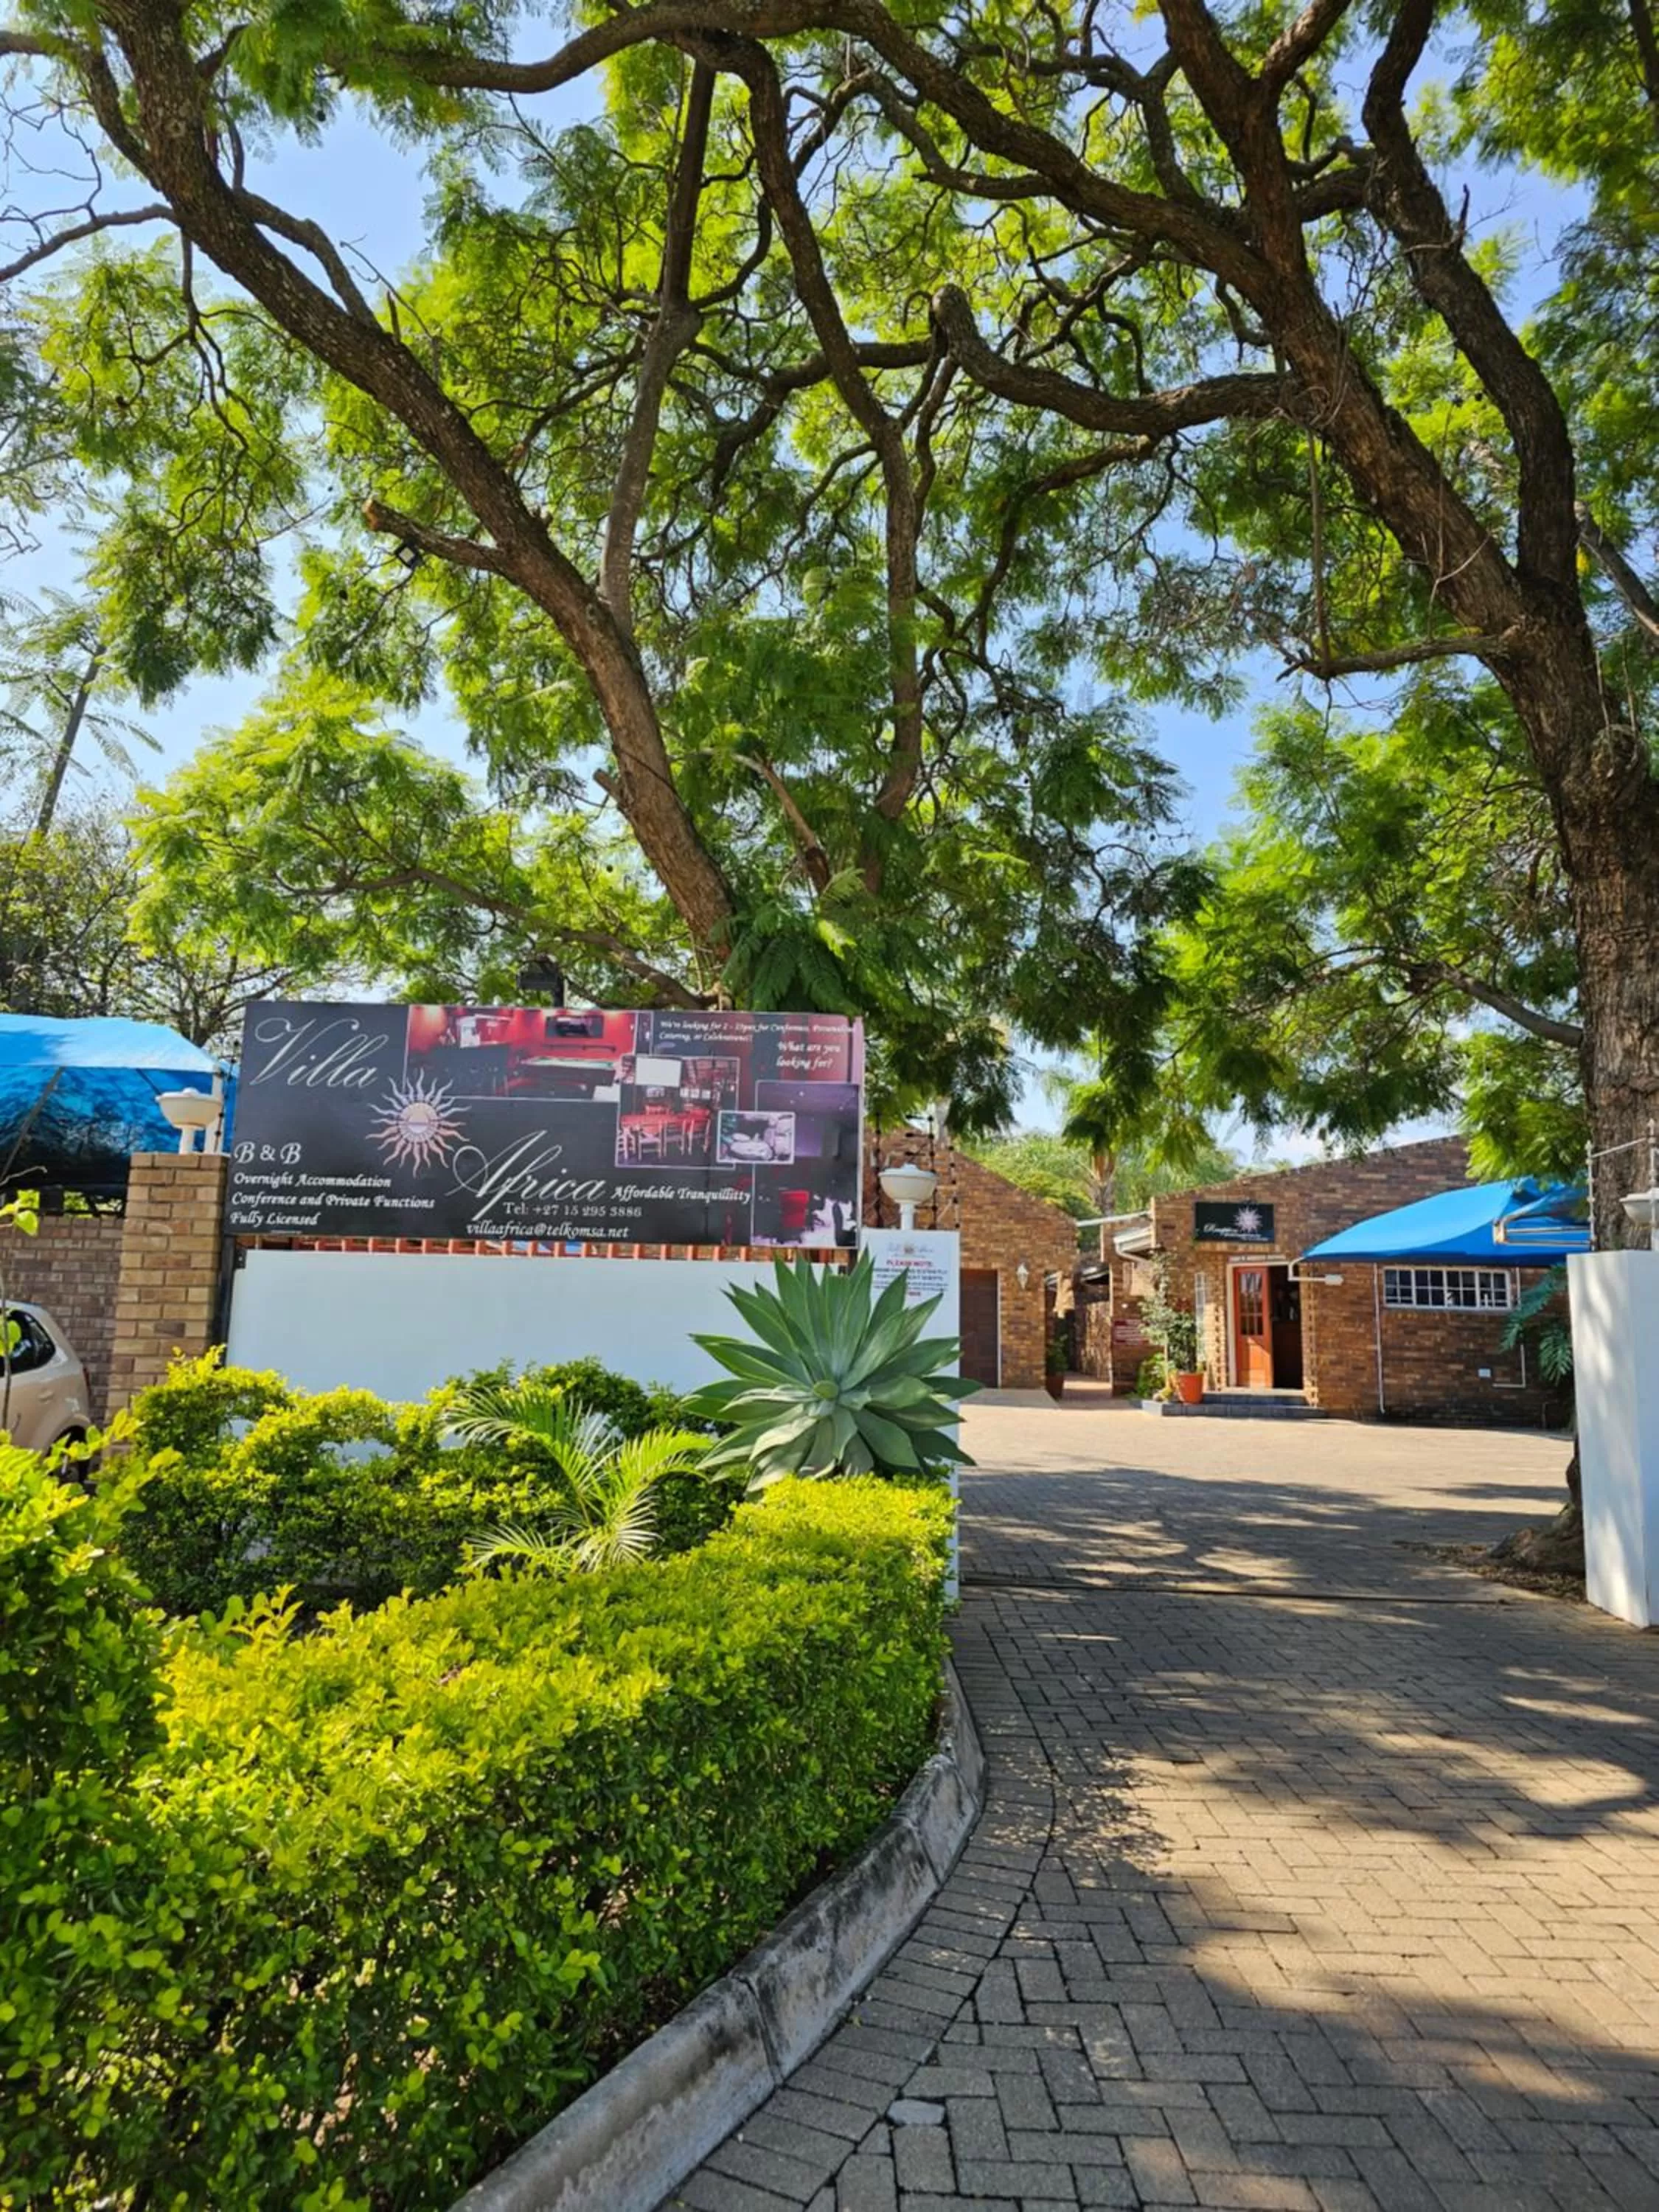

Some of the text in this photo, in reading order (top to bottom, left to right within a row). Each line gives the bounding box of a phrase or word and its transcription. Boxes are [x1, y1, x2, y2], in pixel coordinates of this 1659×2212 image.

[249, 1017, 389, 1088] Villa
[777, 1041, 841, 1055] What are you
[776, 1056, 811, 1070] looking
[234, 1141, 302, 1164] B & B
[234, 1172, 392, 1189] Overnight Accommodation
[445, 1130, 606, 1222] Africa
[232, 1191, 435, 1208] Conference and Private Functions
[611, 1184, 675, 1203] Affordable
[503, 1202, 529, 1215] Tel:
[532, 1204, 560, 1216] +27
[564, 1205, 579, 1216] 15
[582, 1206, 606, 1217] 295
[229, 1210, 321, 1227] Fully Licensed
[466, 1220, 630, 1239] villaafrica@telkomsa.net
